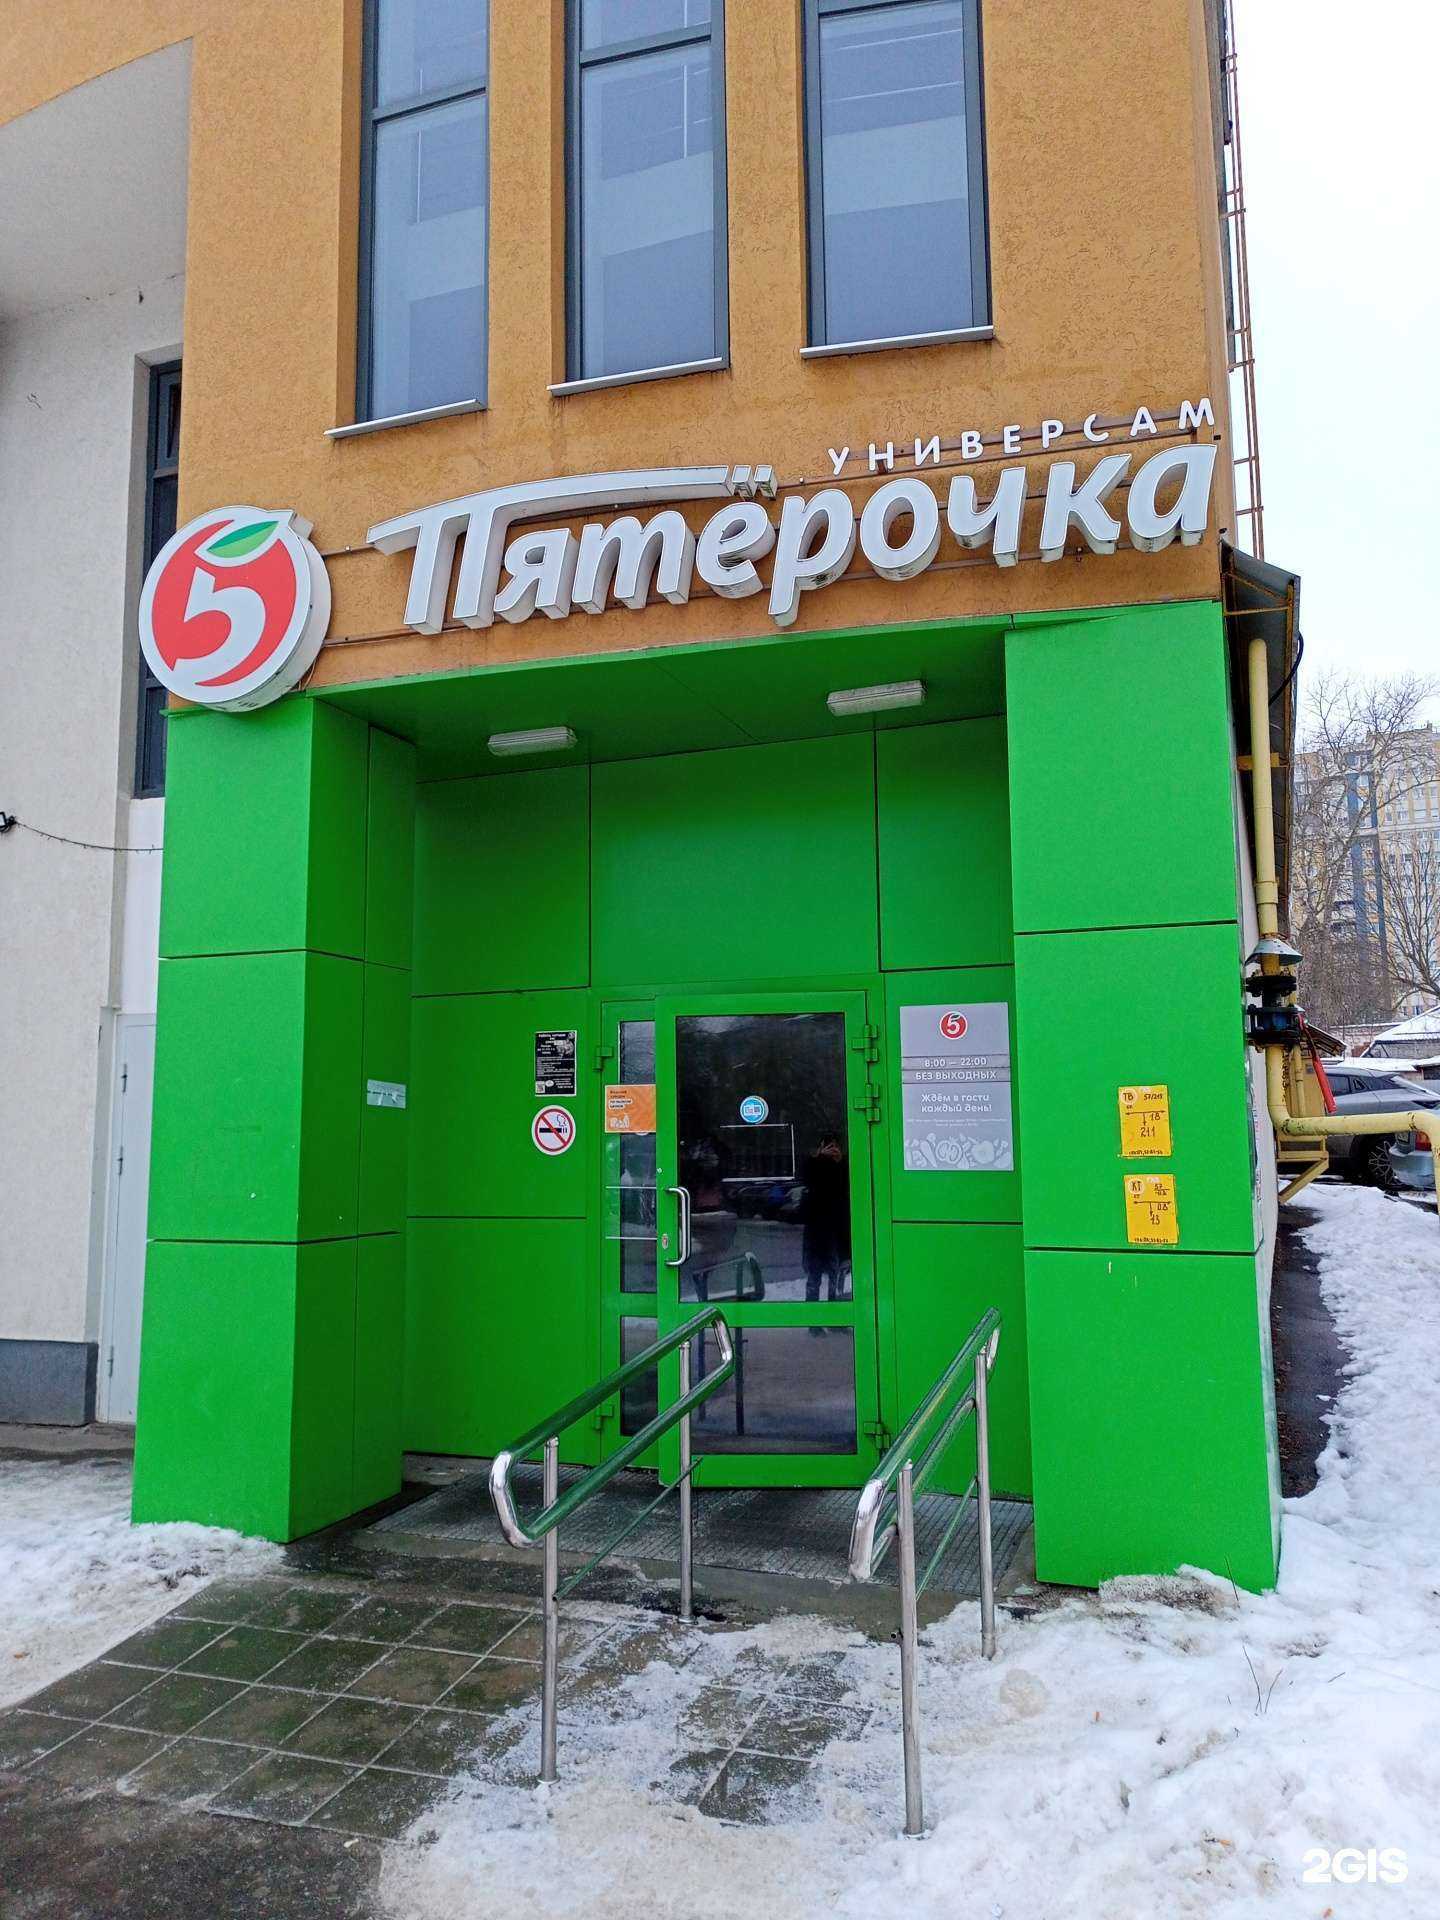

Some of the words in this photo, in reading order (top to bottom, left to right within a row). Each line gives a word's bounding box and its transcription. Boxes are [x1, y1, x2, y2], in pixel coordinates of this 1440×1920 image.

[828, 397, 1215, 475] УНИВЕРСАМ
[366, 443, 1218, 632] Пятёрочка
[924, 1058, 946, 1068] 8:00
[915, 1072, 933, 1080] БЕЗ
[935, 1070, 997, 1081] ВЫХОДНЫХ
[921, 1093, 951, 1102] Ждём
[961, 1094, 990, 1102] гости
[921, 1103, 962, 1113] каждый
[965, 1103, 992, 1113] день!
